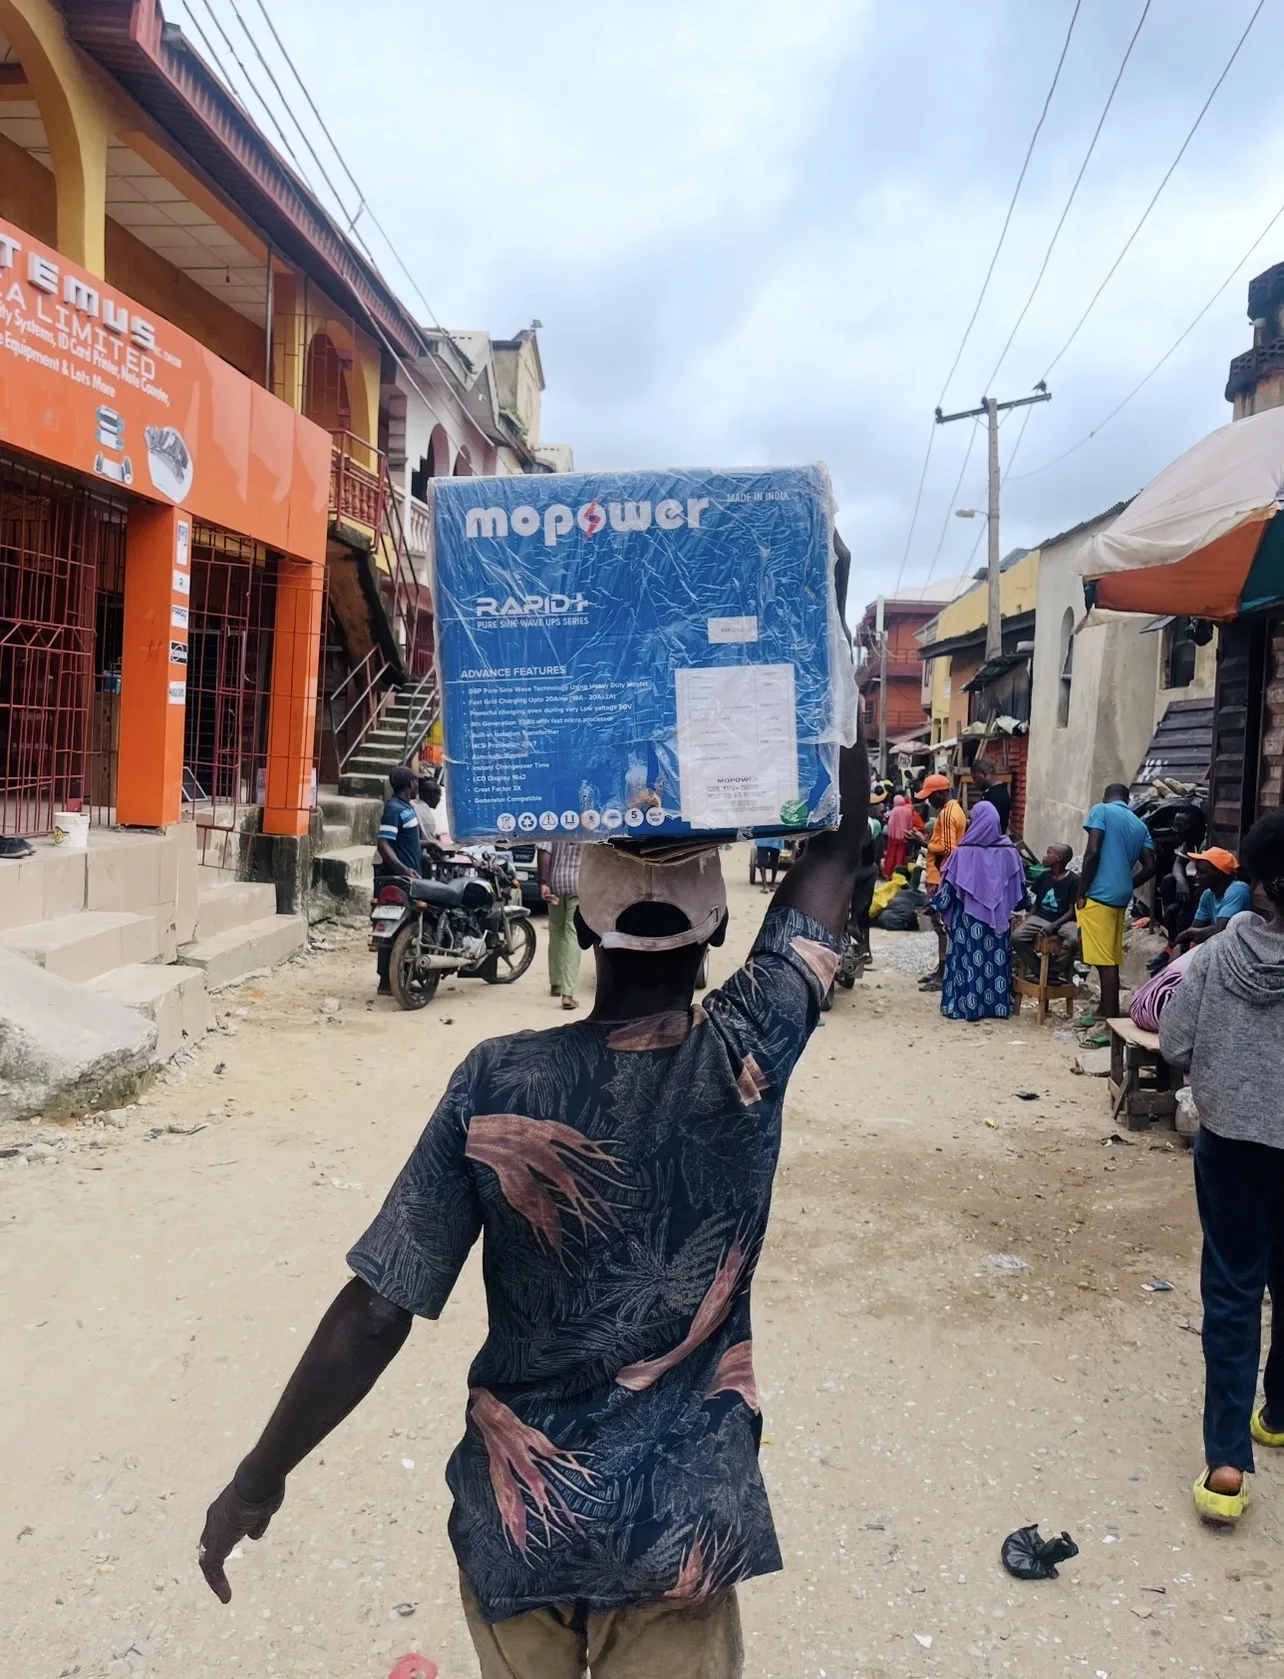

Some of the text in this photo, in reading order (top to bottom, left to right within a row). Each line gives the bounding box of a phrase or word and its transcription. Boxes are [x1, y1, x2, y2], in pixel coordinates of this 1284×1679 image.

[14, 308, 57, 347] Systems,
[70, 337, 92, 362] Card
[37, 295, 155, 380] LIMITED
[5, 330, 59, 373] Equipment
[70, 363, 91, 387] Lots
[91, 373, 116, 398] More
[466, 491, 789, 547] mopower MADE IN INDIA
[476, 616, 589, 630] PURE SINE WAVE UPS SERIES
[460, 665, 567, 679] ADVANCE FEATURES
[533, 684, 568, 693] Technology
[610, 682, 625, 690] Duty
[498, 697, 527, 705] Charging
[528, 696, 544, 704] Upto
[498, 708, 526, 716] charging
[544, 706, 564, 714] during
[580, 705, 592, 713] Low
[594, 704, 618, 713] voltage
[482, 719, 516, 728] Generation
[521, 728, 560, 737] Transformer
[495, 763, 533, 771] Changeover
[487, 774, 511, 782] Display
[506, 795, 543, 803] Compatible
